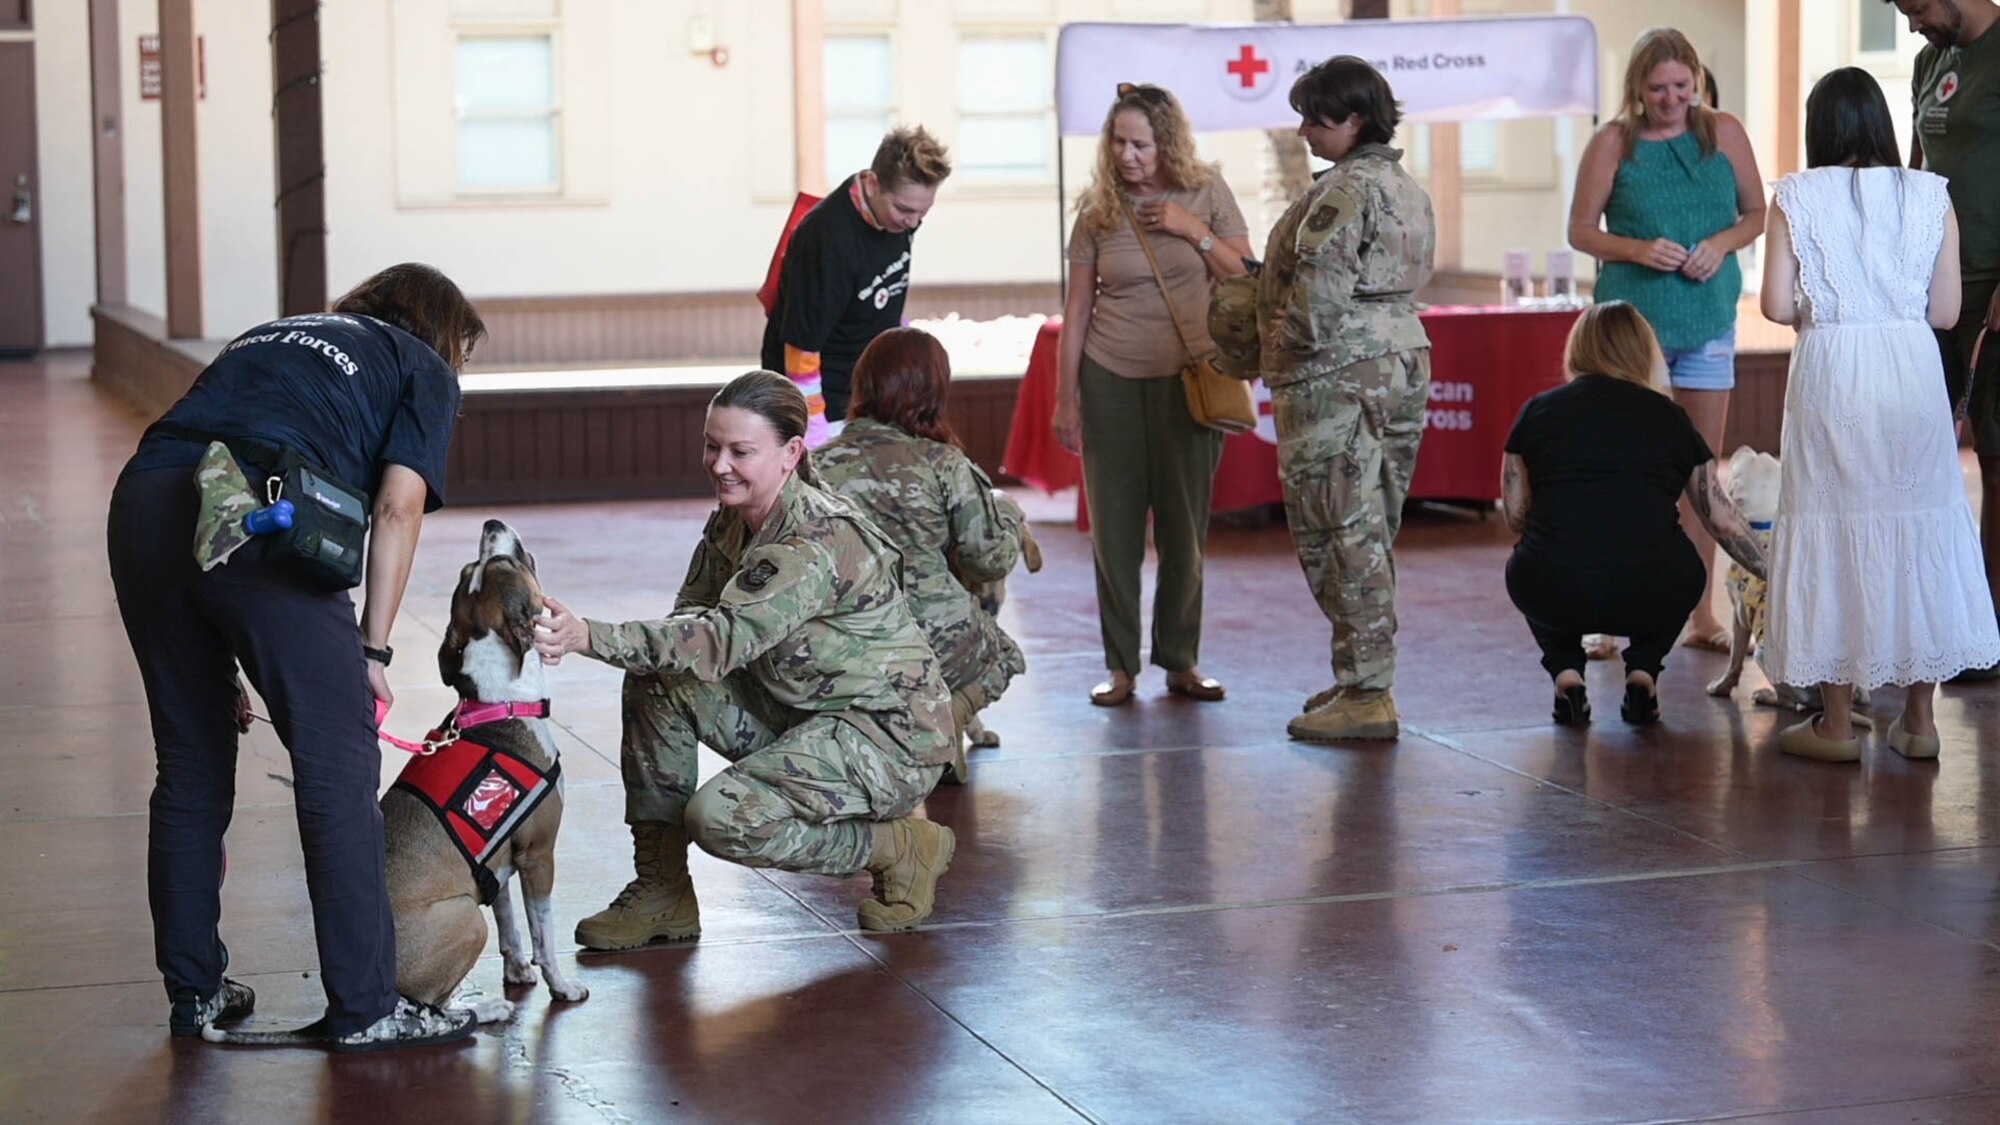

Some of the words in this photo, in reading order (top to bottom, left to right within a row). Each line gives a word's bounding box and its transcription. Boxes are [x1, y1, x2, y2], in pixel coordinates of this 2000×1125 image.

[1393, 54, 1428, 71] Red
[1432, 53, 1486, 69] Cross
[280, 330, 359, 376] Forces
[1429, 381, 1474, 402] can
[1423, 409, 1473, 430] ross
